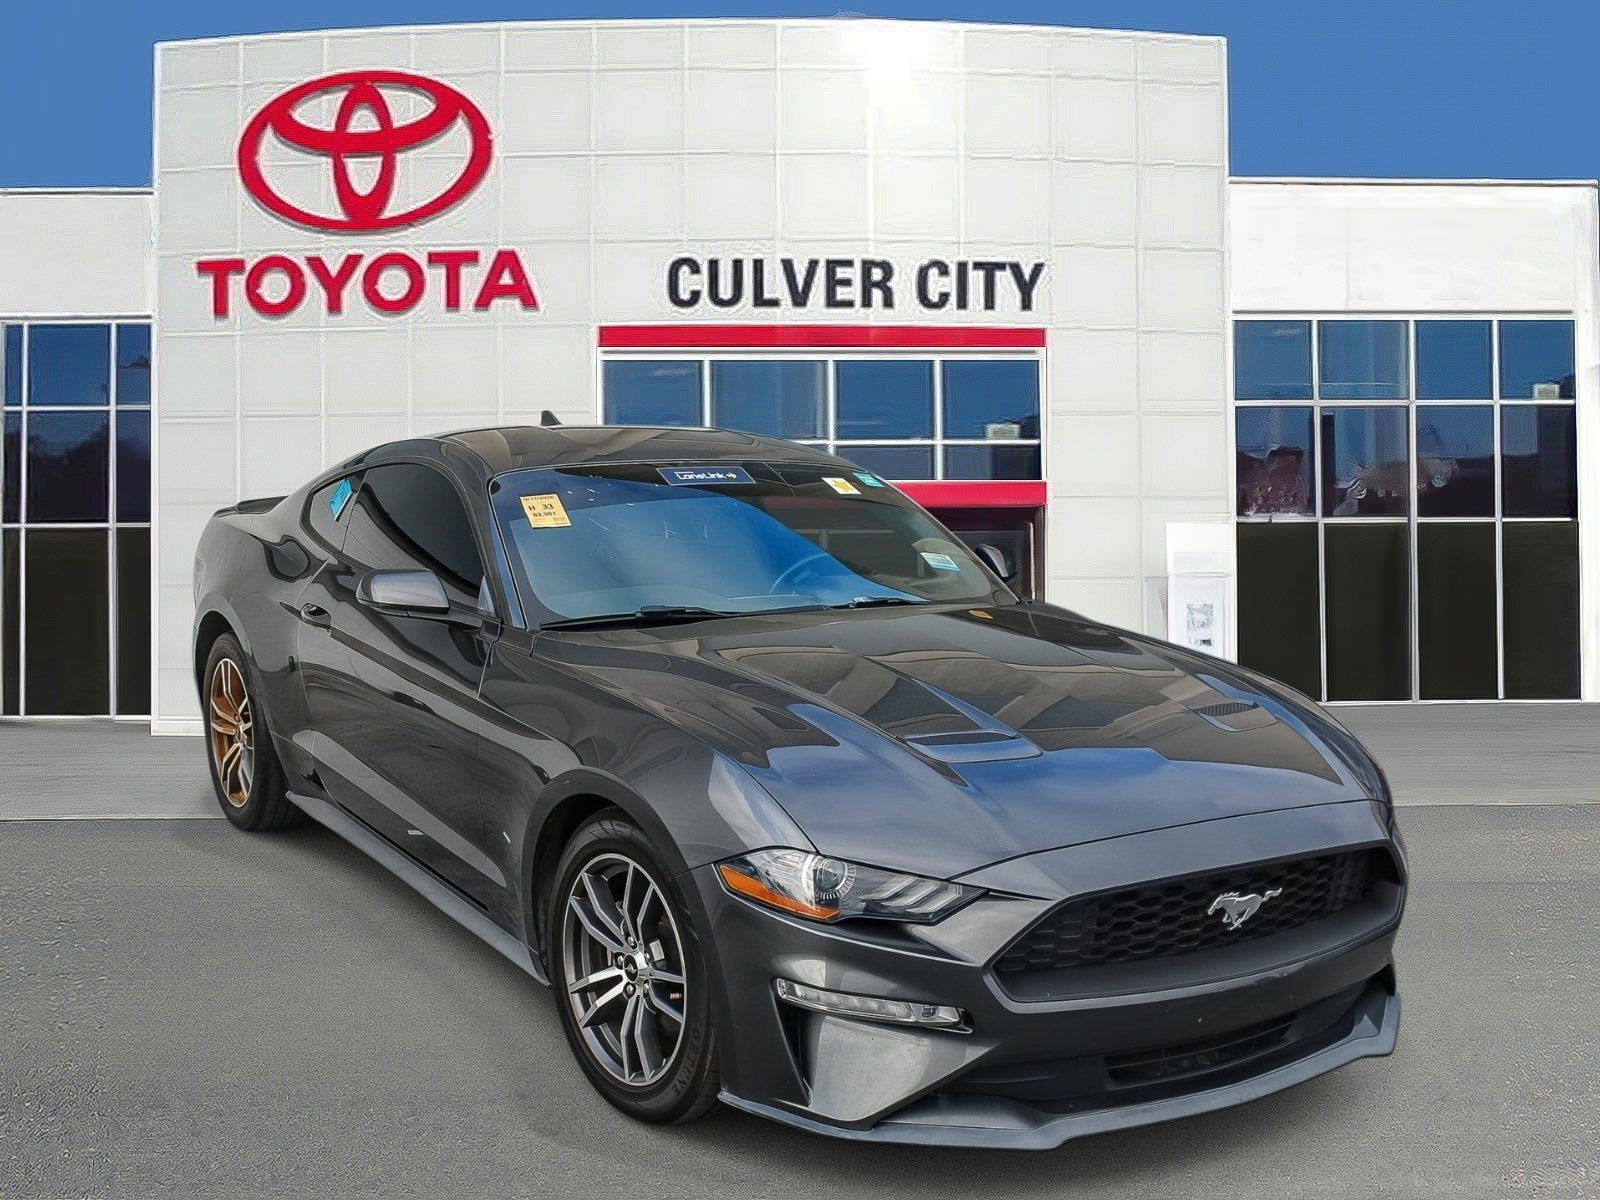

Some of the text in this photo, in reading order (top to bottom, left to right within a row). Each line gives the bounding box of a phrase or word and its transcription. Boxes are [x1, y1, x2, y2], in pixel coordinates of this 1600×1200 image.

[196, 249, 540, 319] TOYOTA
[667, 256, 1046, 311] CULVER CITY
